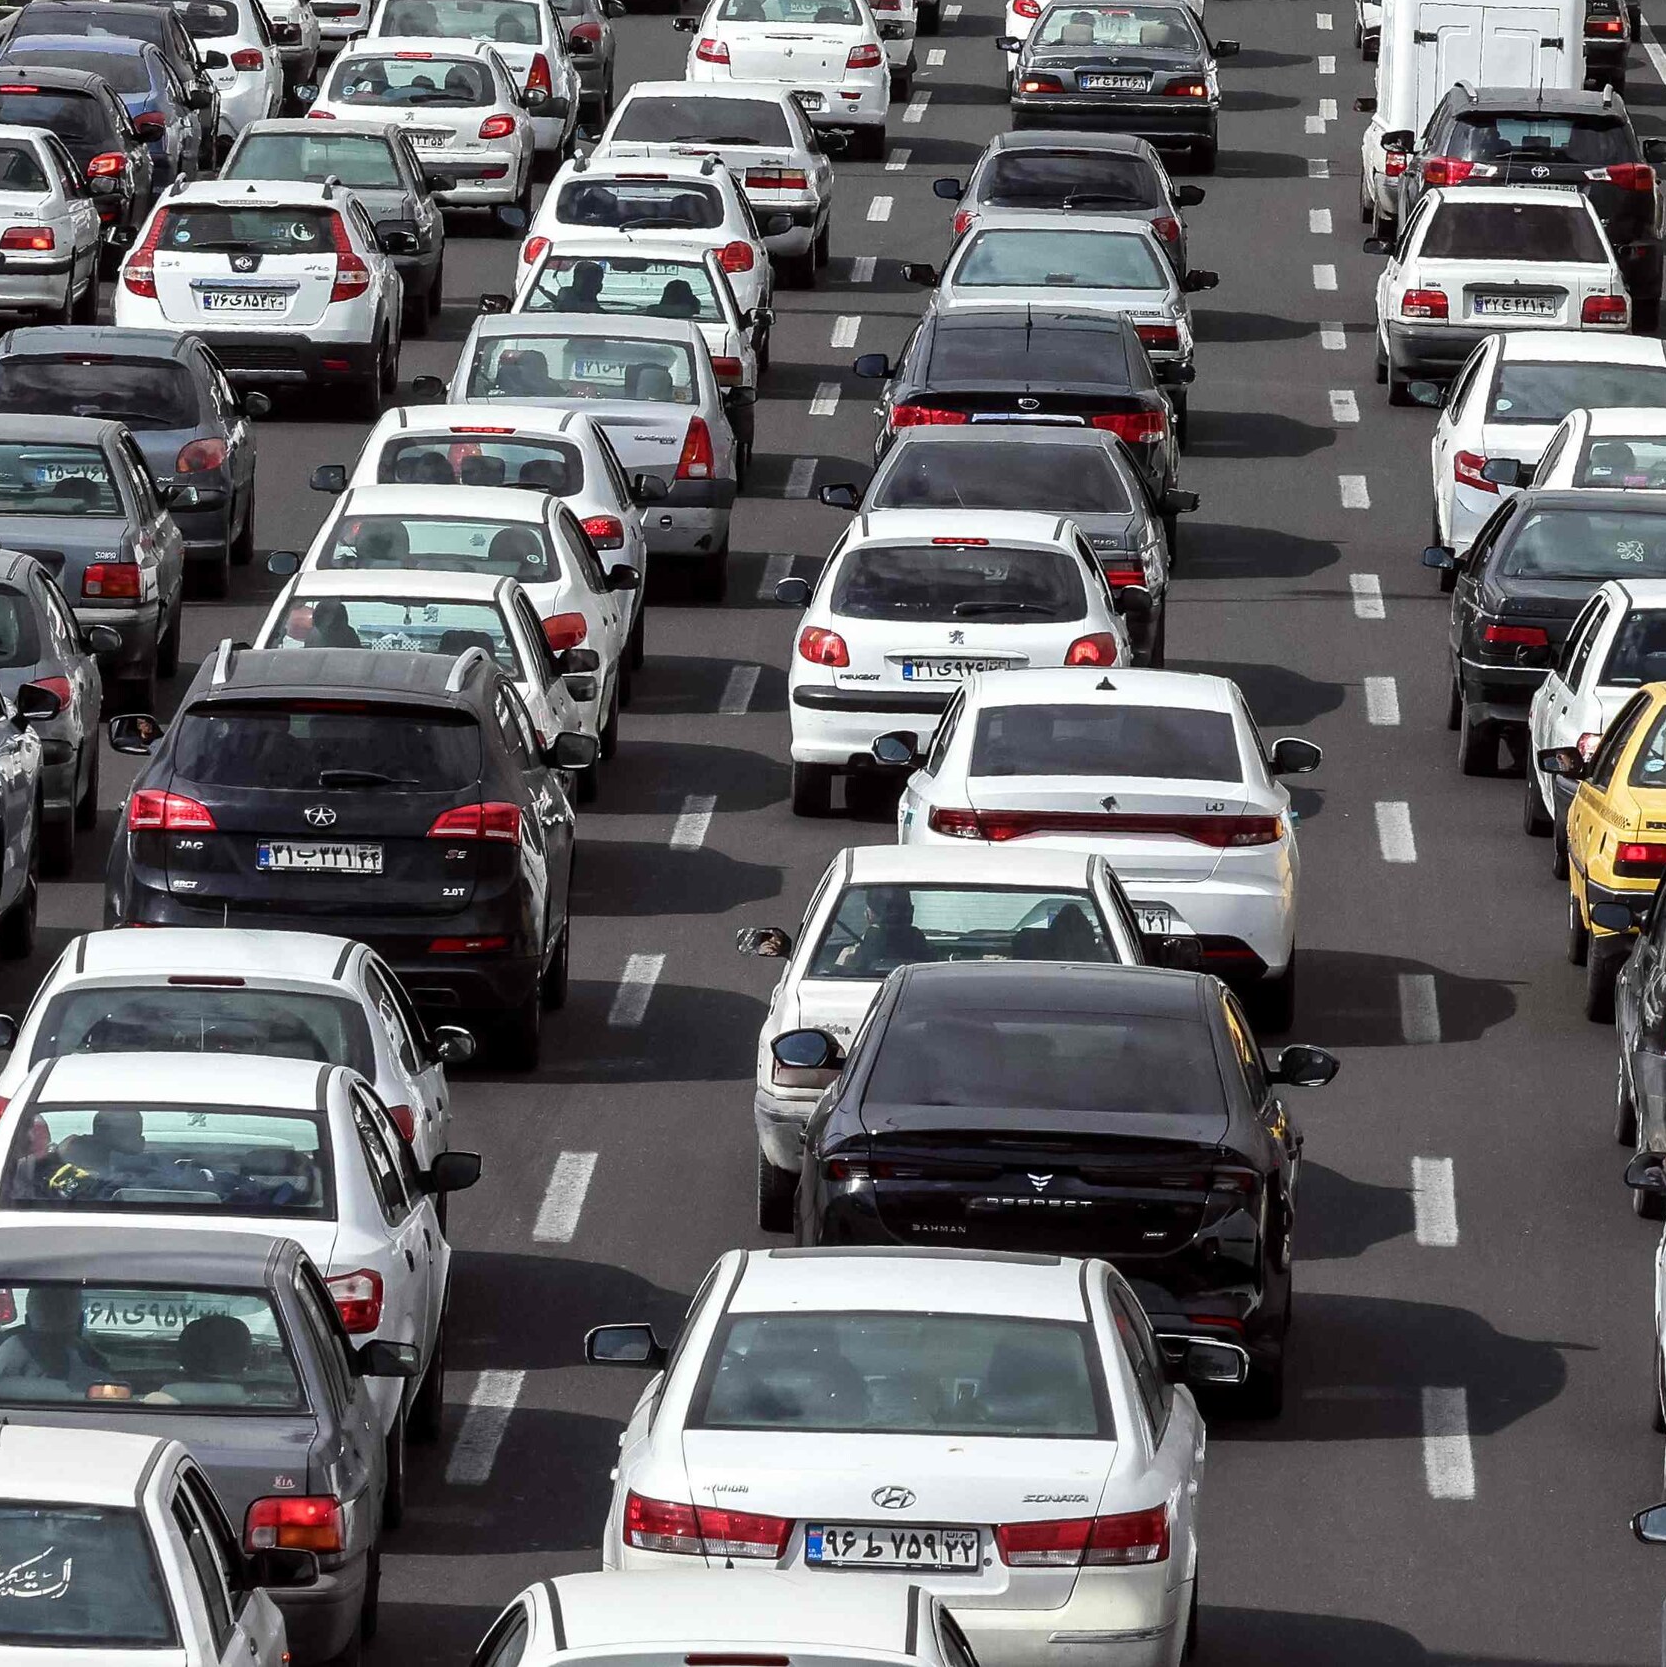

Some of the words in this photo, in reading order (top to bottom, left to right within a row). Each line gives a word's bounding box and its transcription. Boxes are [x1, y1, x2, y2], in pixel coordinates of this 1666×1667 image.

[176, 840, 204, 851] JAC
[442, 888, 466, 896] 2.0T
[912, 1223, 967, 1234] BAHMAN
[275, 1475, 294, 1488] KIA
[1022, 1494, 1090, 1504] SONATA
[944, 1540, 975, 1563] ۲۲
